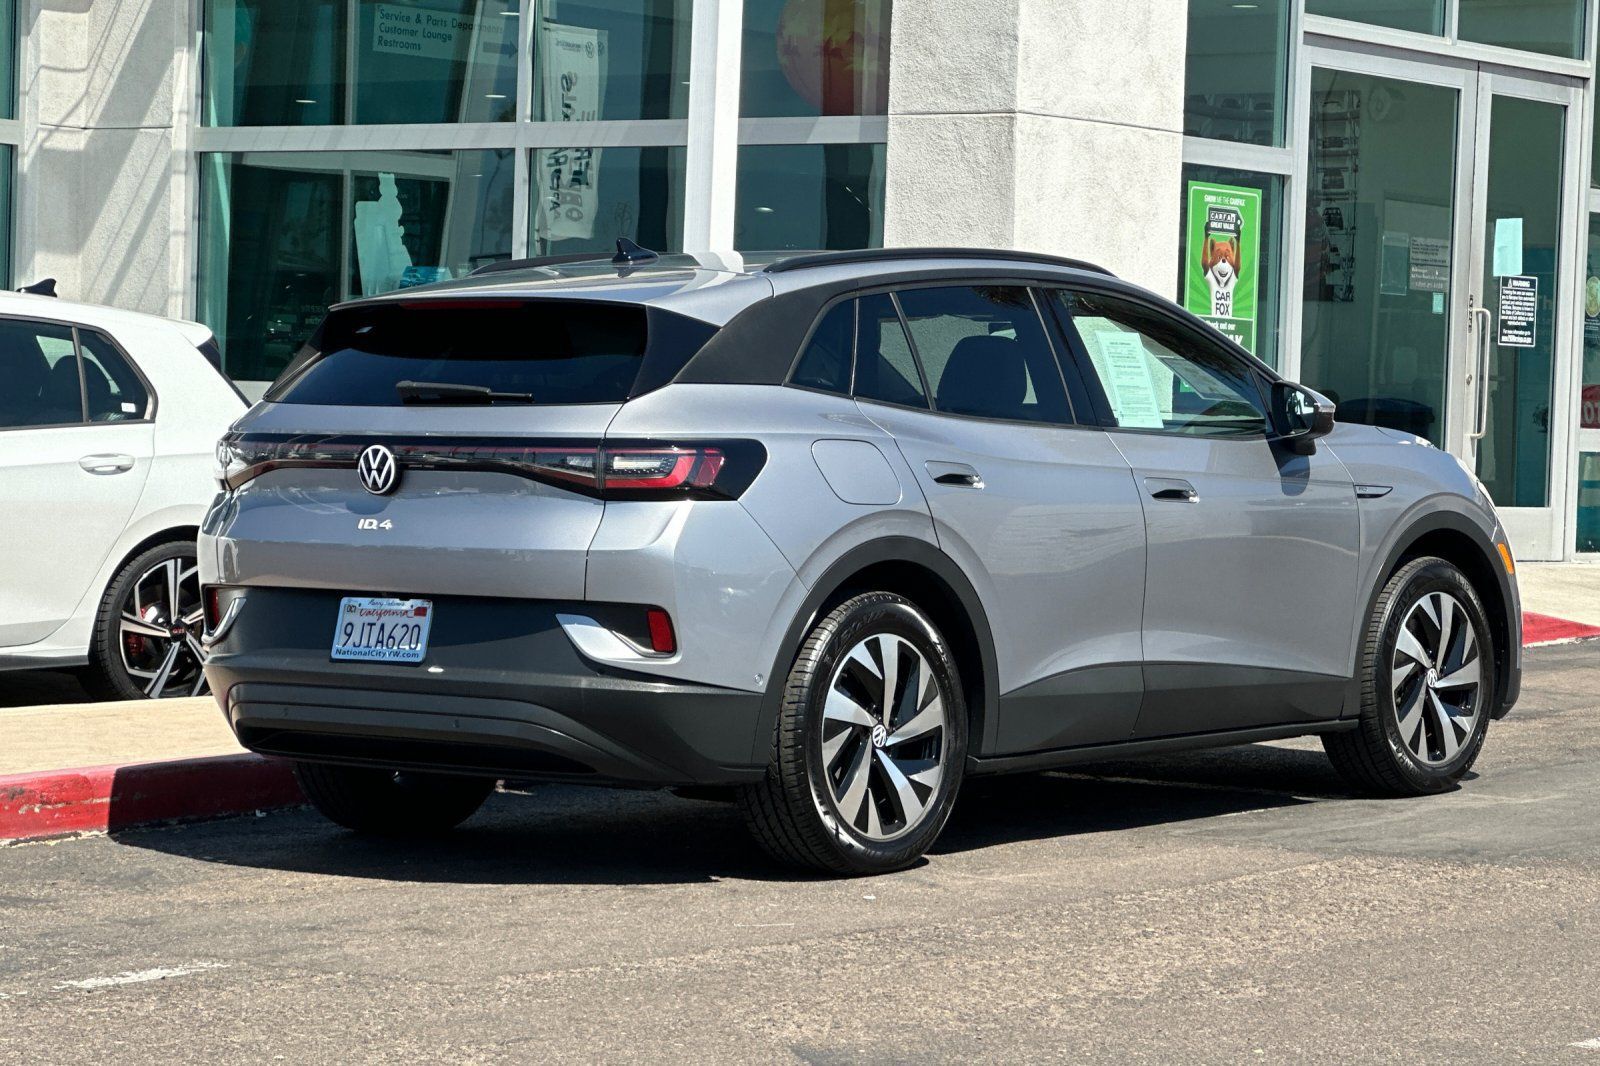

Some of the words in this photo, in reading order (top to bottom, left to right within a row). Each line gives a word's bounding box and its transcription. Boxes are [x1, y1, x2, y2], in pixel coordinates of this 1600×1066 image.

[379, 9, 411, 23] Service
[415, 13, 422, 25] &
[426, 14, 447, 28] Parts
[379, 22, 419, 37] Customer
[422, 27, 453, 43] Lounge
[377, 35, 421, 50] Restrooms
[1215, 291, 1231, 301] CAR
[1215, 302, 1230, 316] FOX
[359, 607, 409, 621] California
[342, 622, 421, 650] 9JIA620
[335, 648, 420, 659] NationalCityVW.com
